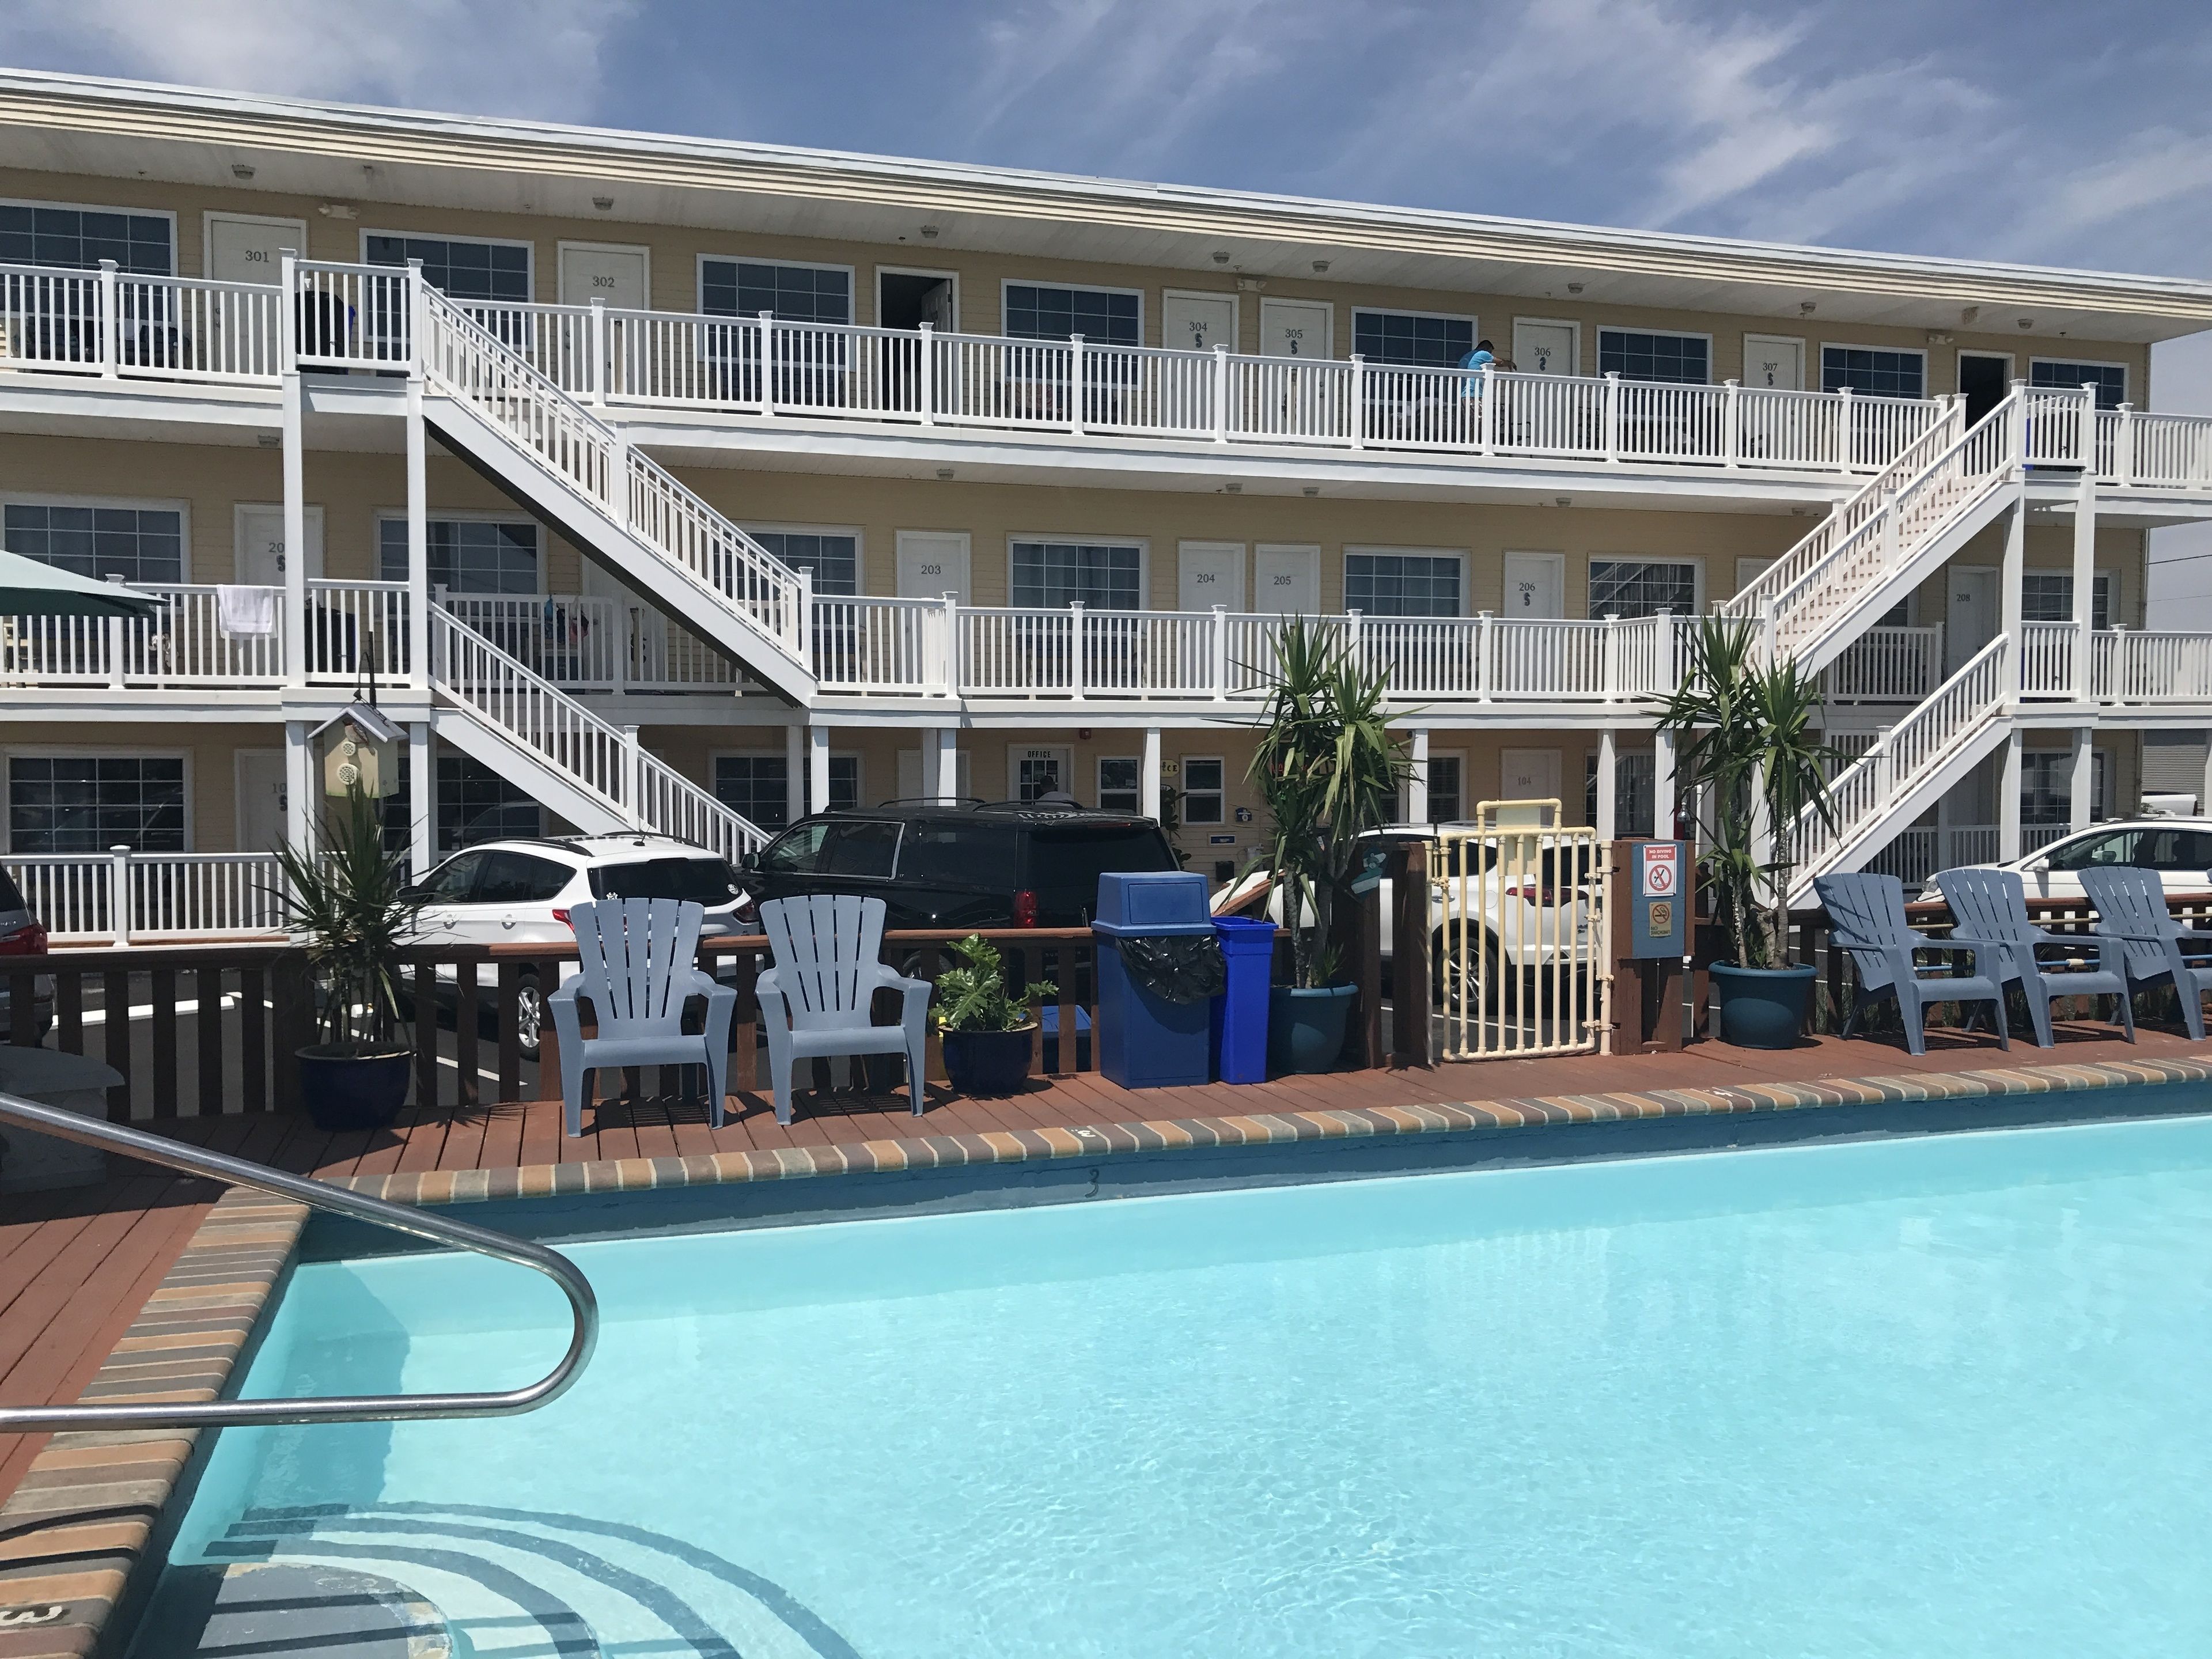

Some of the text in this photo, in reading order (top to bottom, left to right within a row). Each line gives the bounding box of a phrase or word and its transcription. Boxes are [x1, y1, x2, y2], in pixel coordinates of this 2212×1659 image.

[245, 249, 269, 263] 301
[592, 275, 615, 287] 302
[1189, 321, 1207, 332] 304
[1285, 328, 1303, 339] 305
[1534, 347, 1551, 357] 306
[1763, 362, 1778, 371] 307
[268, 542, 285, 553] 20
[921, 565, 941, 574] 203
[1197, 574, 1215, 583] 204
[1274, 575, 1291, 585] 205
[1519, 582, 1536, 591] 206
[1956, 593, 1971, 602] 208
[1518, 777, 1532, 786] 104
[272, 782, 287, 793] 10
